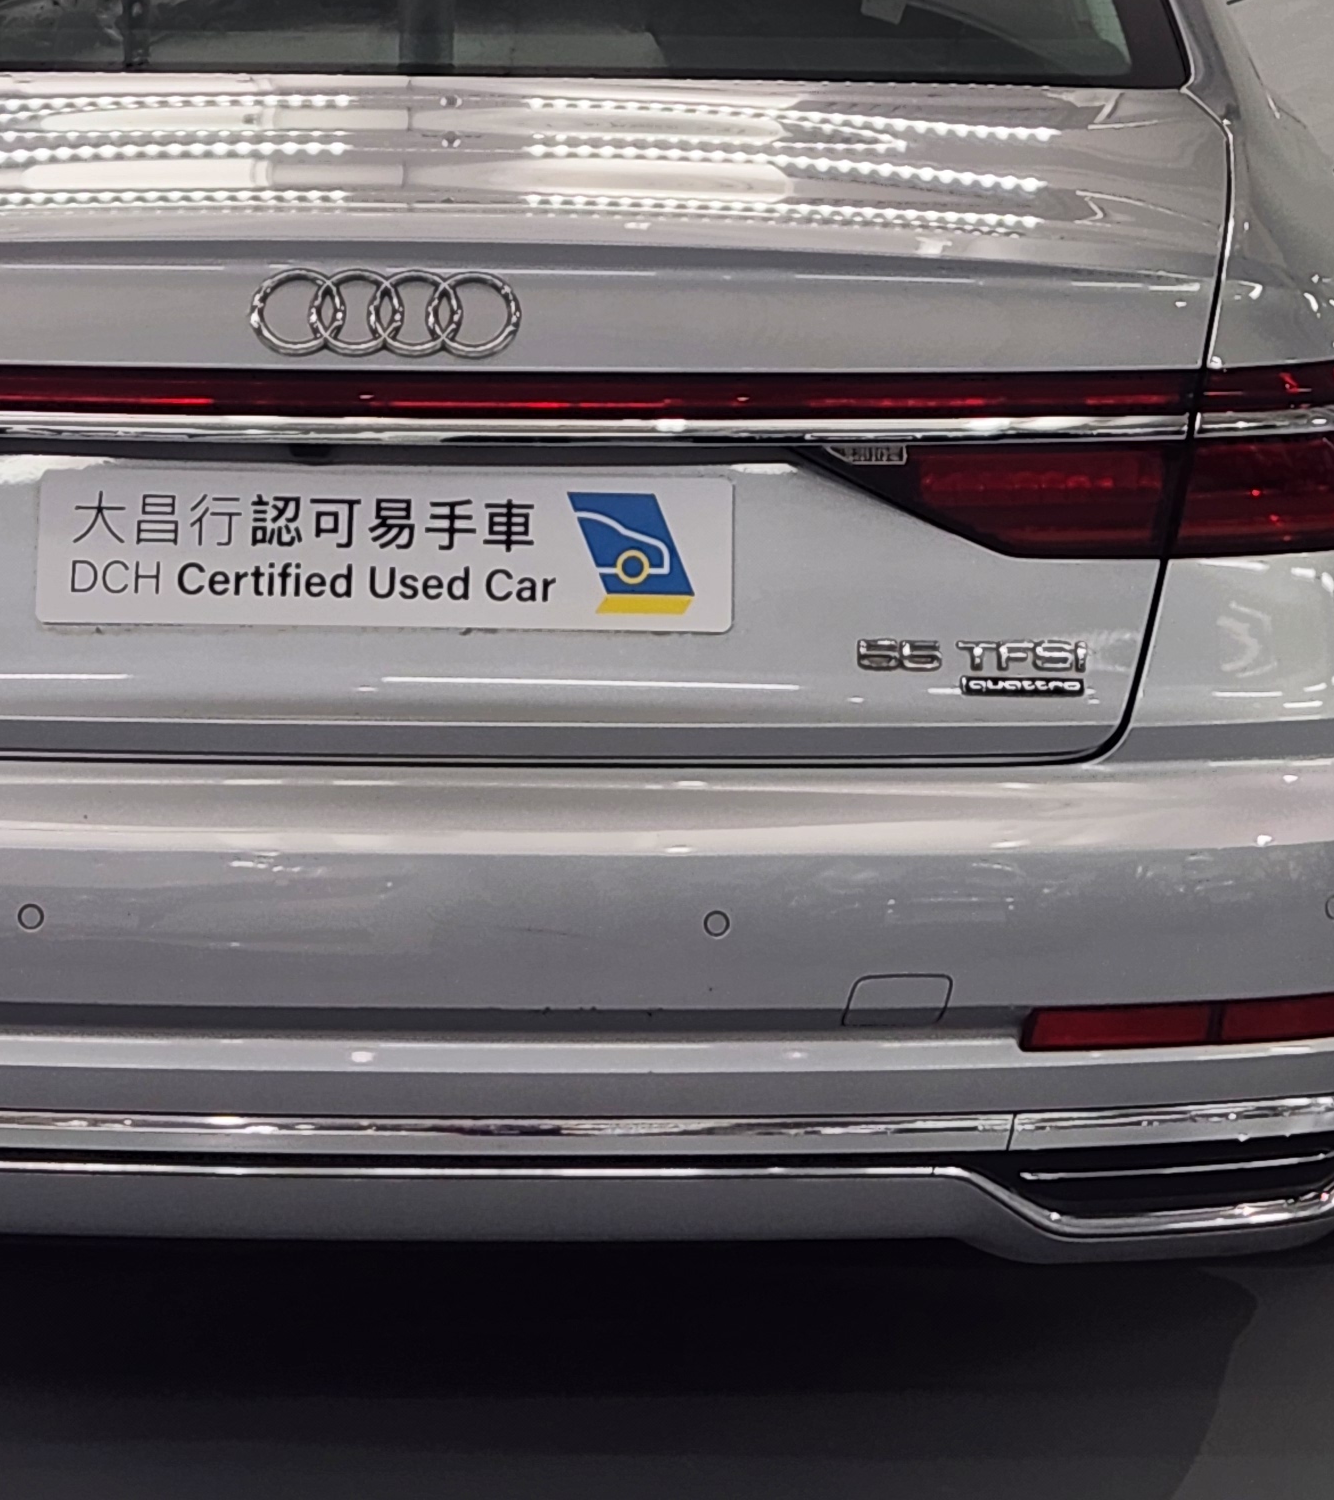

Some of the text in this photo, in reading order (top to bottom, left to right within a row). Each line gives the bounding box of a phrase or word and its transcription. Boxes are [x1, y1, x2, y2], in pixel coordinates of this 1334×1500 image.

[71, 489, 536, 554] 大昌行認可易手車
[69, 559, 557, 604] DCH Certified Used Car
[856, 637, 943, 672] 55
[967, 679, 1082, 693] quattro
